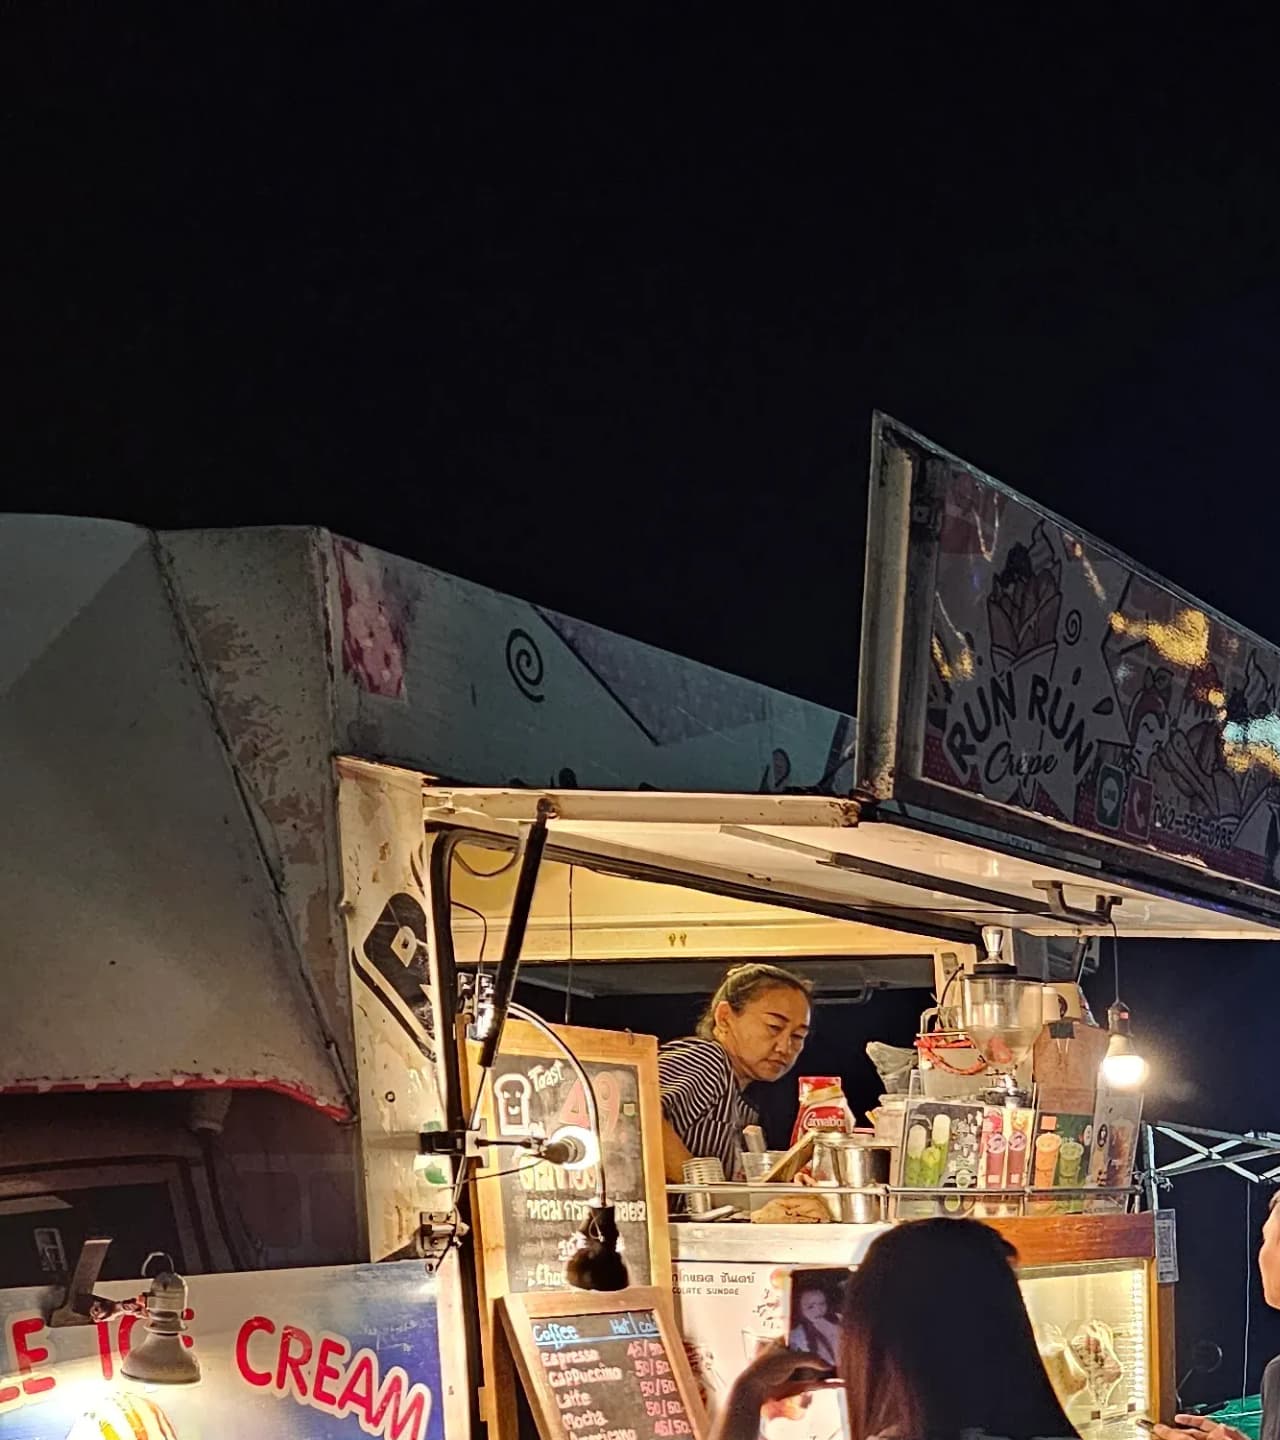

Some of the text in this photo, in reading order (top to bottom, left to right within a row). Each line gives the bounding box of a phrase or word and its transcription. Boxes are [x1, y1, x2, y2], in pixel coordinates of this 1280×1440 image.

[946, 671, 1094, 775] RUN RUN
[528, 1060, 564, 1092] Toast
[706, 1287, 740, 1296] SUNDAE
[533, 1322, 579, 1350] Coffee
[540, 1349, 600, 1371] Espresso
[549, 1362, 623, 1388] Cappuccino
[555, 1388, 592, 1409] Latte
[562, 1409, 608, 1431] Mocha
